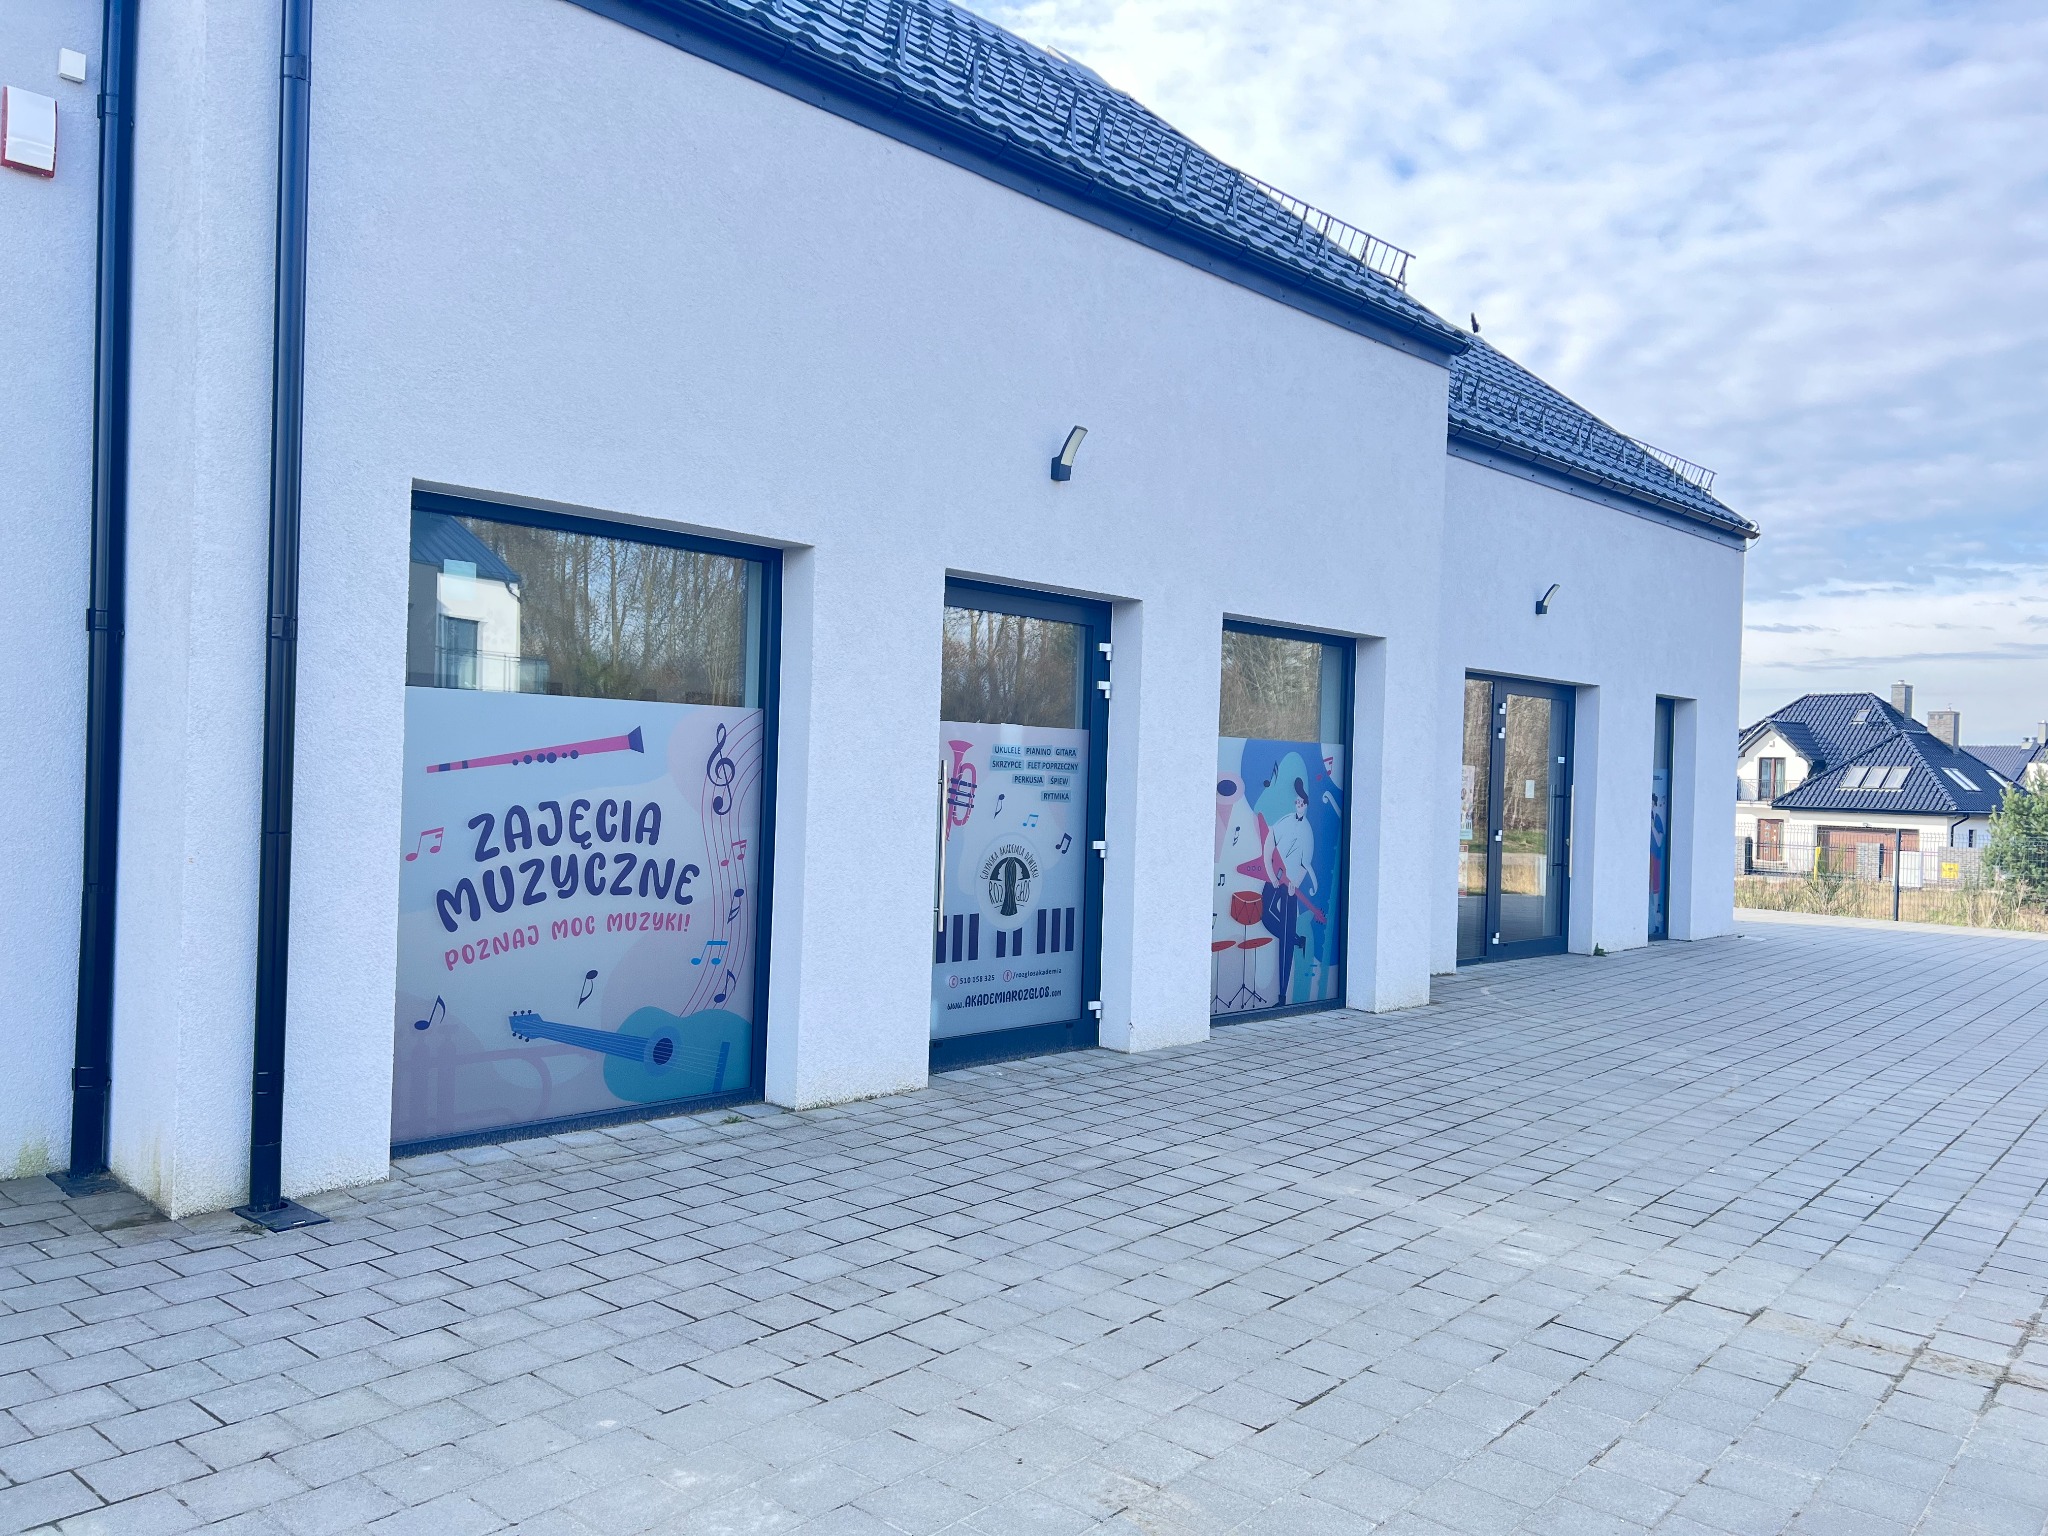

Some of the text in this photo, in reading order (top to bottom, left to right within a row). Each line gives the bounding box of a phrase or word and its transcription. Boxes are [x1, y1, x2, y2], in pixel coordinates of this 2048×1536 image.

[994, 746, 1077, 757] UKULELE PIANINO GITARA
[992, 760, 1079, 771] SKRZYPCE FLET POPRZECZNY
[1014, 775, 1069, 785] PERKUSJA ŚPIEW
[1043, 792, 1070, 801] RYTMIKA
[468, 798, 662, 862] ZAJĘCIA
[436, 852, 700, 933] MUZYCZNE
[444, 911, 690, 971] POZNAJ MOC MUZYKI!
